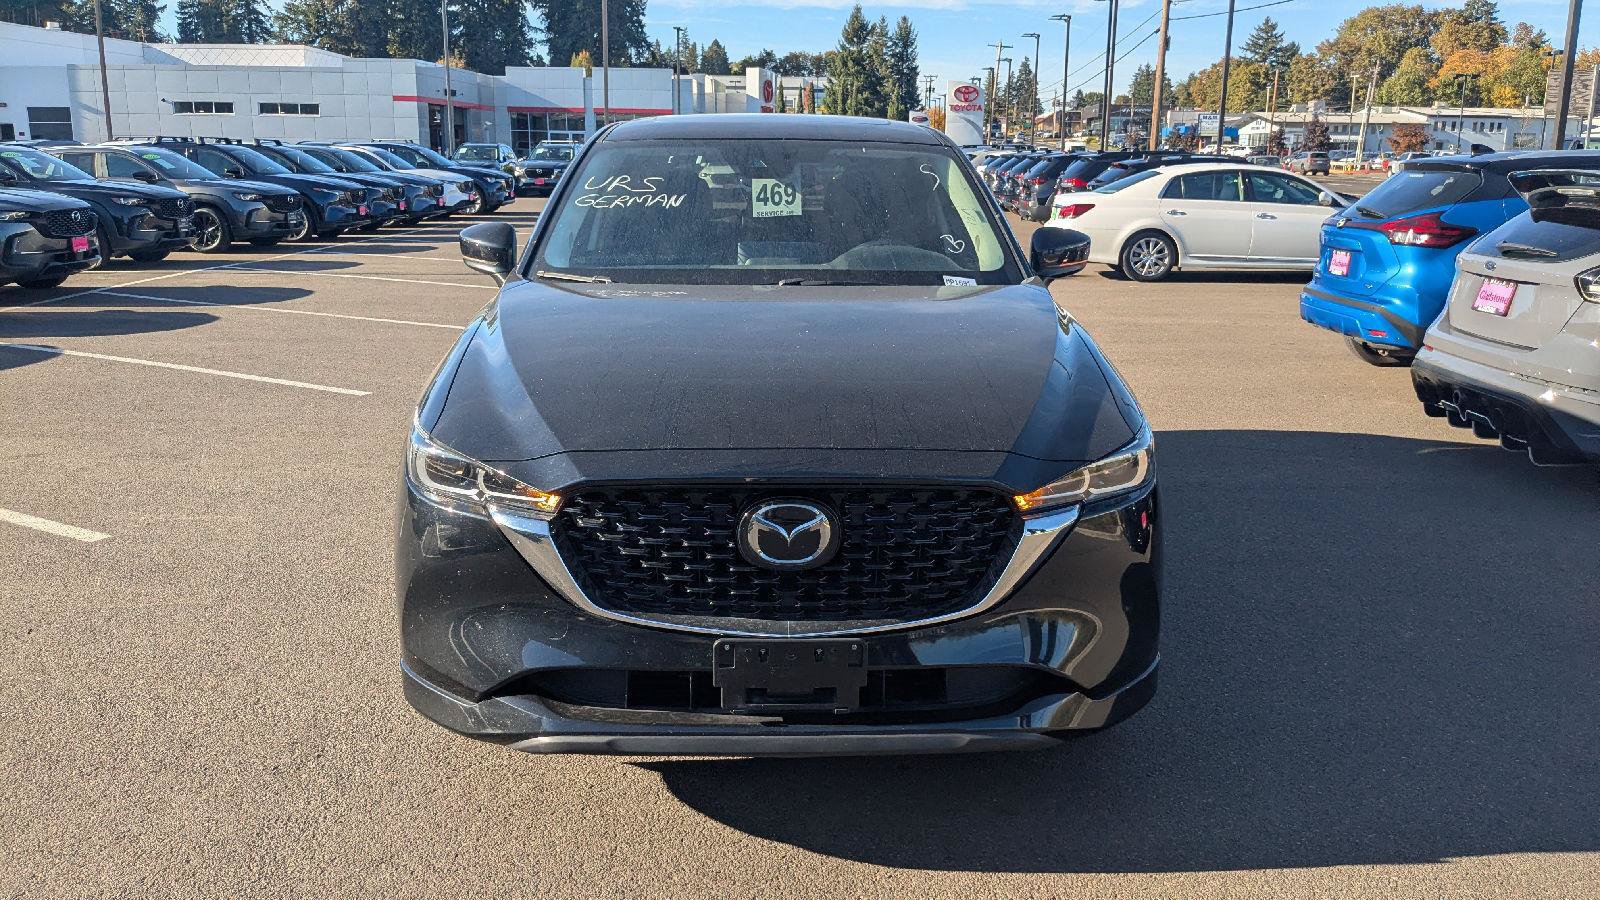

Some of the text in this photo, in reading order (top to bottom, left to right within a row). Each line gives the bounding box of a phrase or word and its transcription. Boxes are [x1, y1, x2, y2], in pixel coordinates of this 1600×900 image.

[949, 104, 983, 112] TOYOTA
[574, 193, 688, 209] GERMAN
[755, 182, 797, 207] 469
